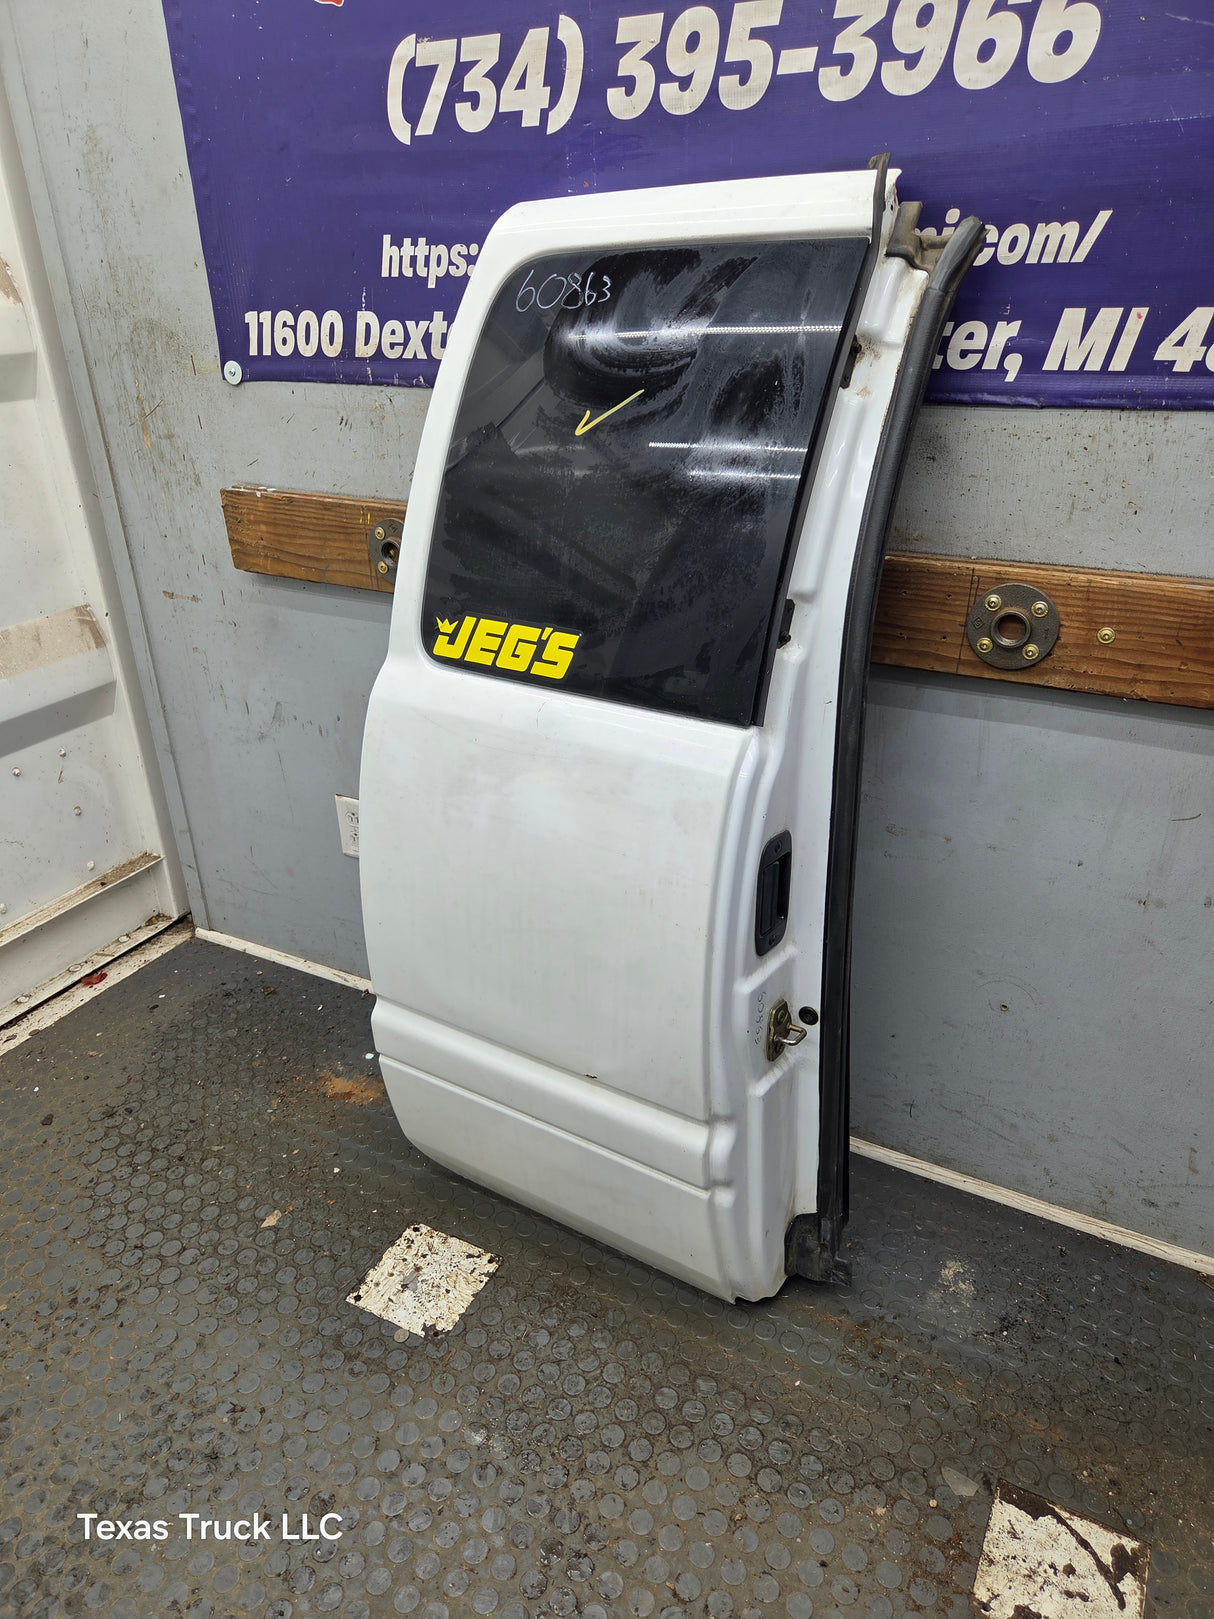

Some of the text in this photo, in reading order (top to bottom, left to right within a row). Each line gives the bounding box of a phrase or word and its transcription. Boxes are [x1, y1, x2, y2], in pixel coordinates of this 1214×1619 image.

[387, 0, 1101, 146] (734) 395-3966
[381, 234, 480, 288] https:
[515, 269, 611, 313] 60863
[244, 309, 344, 358] 11600
[354, 310, 454, 360] Dext
[1042, 307, 1150, 372] MI
[1153, 306, 1214, 373] 4
[432, 615, 580, 680] JEG'S
